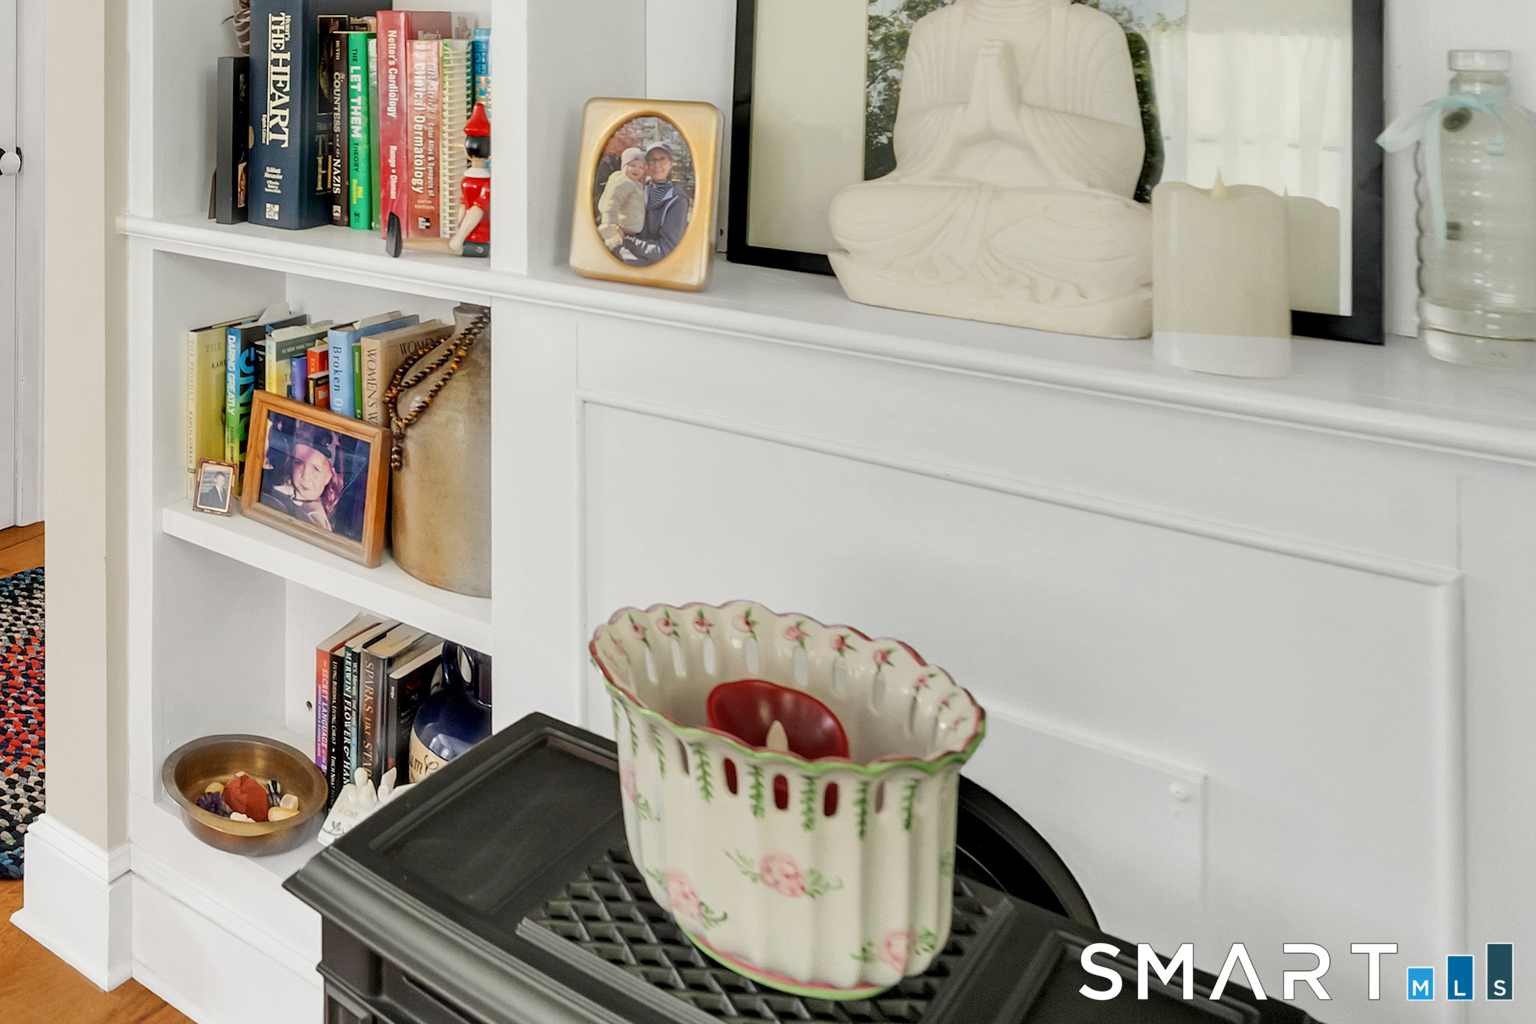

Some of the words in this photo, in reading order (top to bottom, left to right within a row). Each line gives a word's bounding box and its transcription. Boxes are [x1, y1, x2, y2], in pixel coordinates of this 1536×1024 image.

[270, 11, 287, 51] THE
[387, 29, 398, 66] Netter's
[269, 50, 292, 149] HEART
[350, 65, 362, 92] LET
[386, 67, 399, 119] Cardiology
[413, 62, 426, 111] Clinical
[333, 71, 342, 133] COUNTESS
[350, 96, 363, 139] THEM
[332, 158, 342, 194] NAZIS
[352, 142, 360, 173] THEORY
[411, 115, 427, 194] Dermatology
[426, 162, 435, 189] Synopsis
[204, 342, 223, 354] THE
[227, 334, 237, 372] DARING
[332, 346, 344, 392] Broken
[226, 372, 236, 416] GREATLY
[321, 668, 329, 701] SECRET
[344, 650, 352, 694] MERWIN
[363, 659, 375, 714] SPARKS
[342, 698, 351, 744] FLOWER
